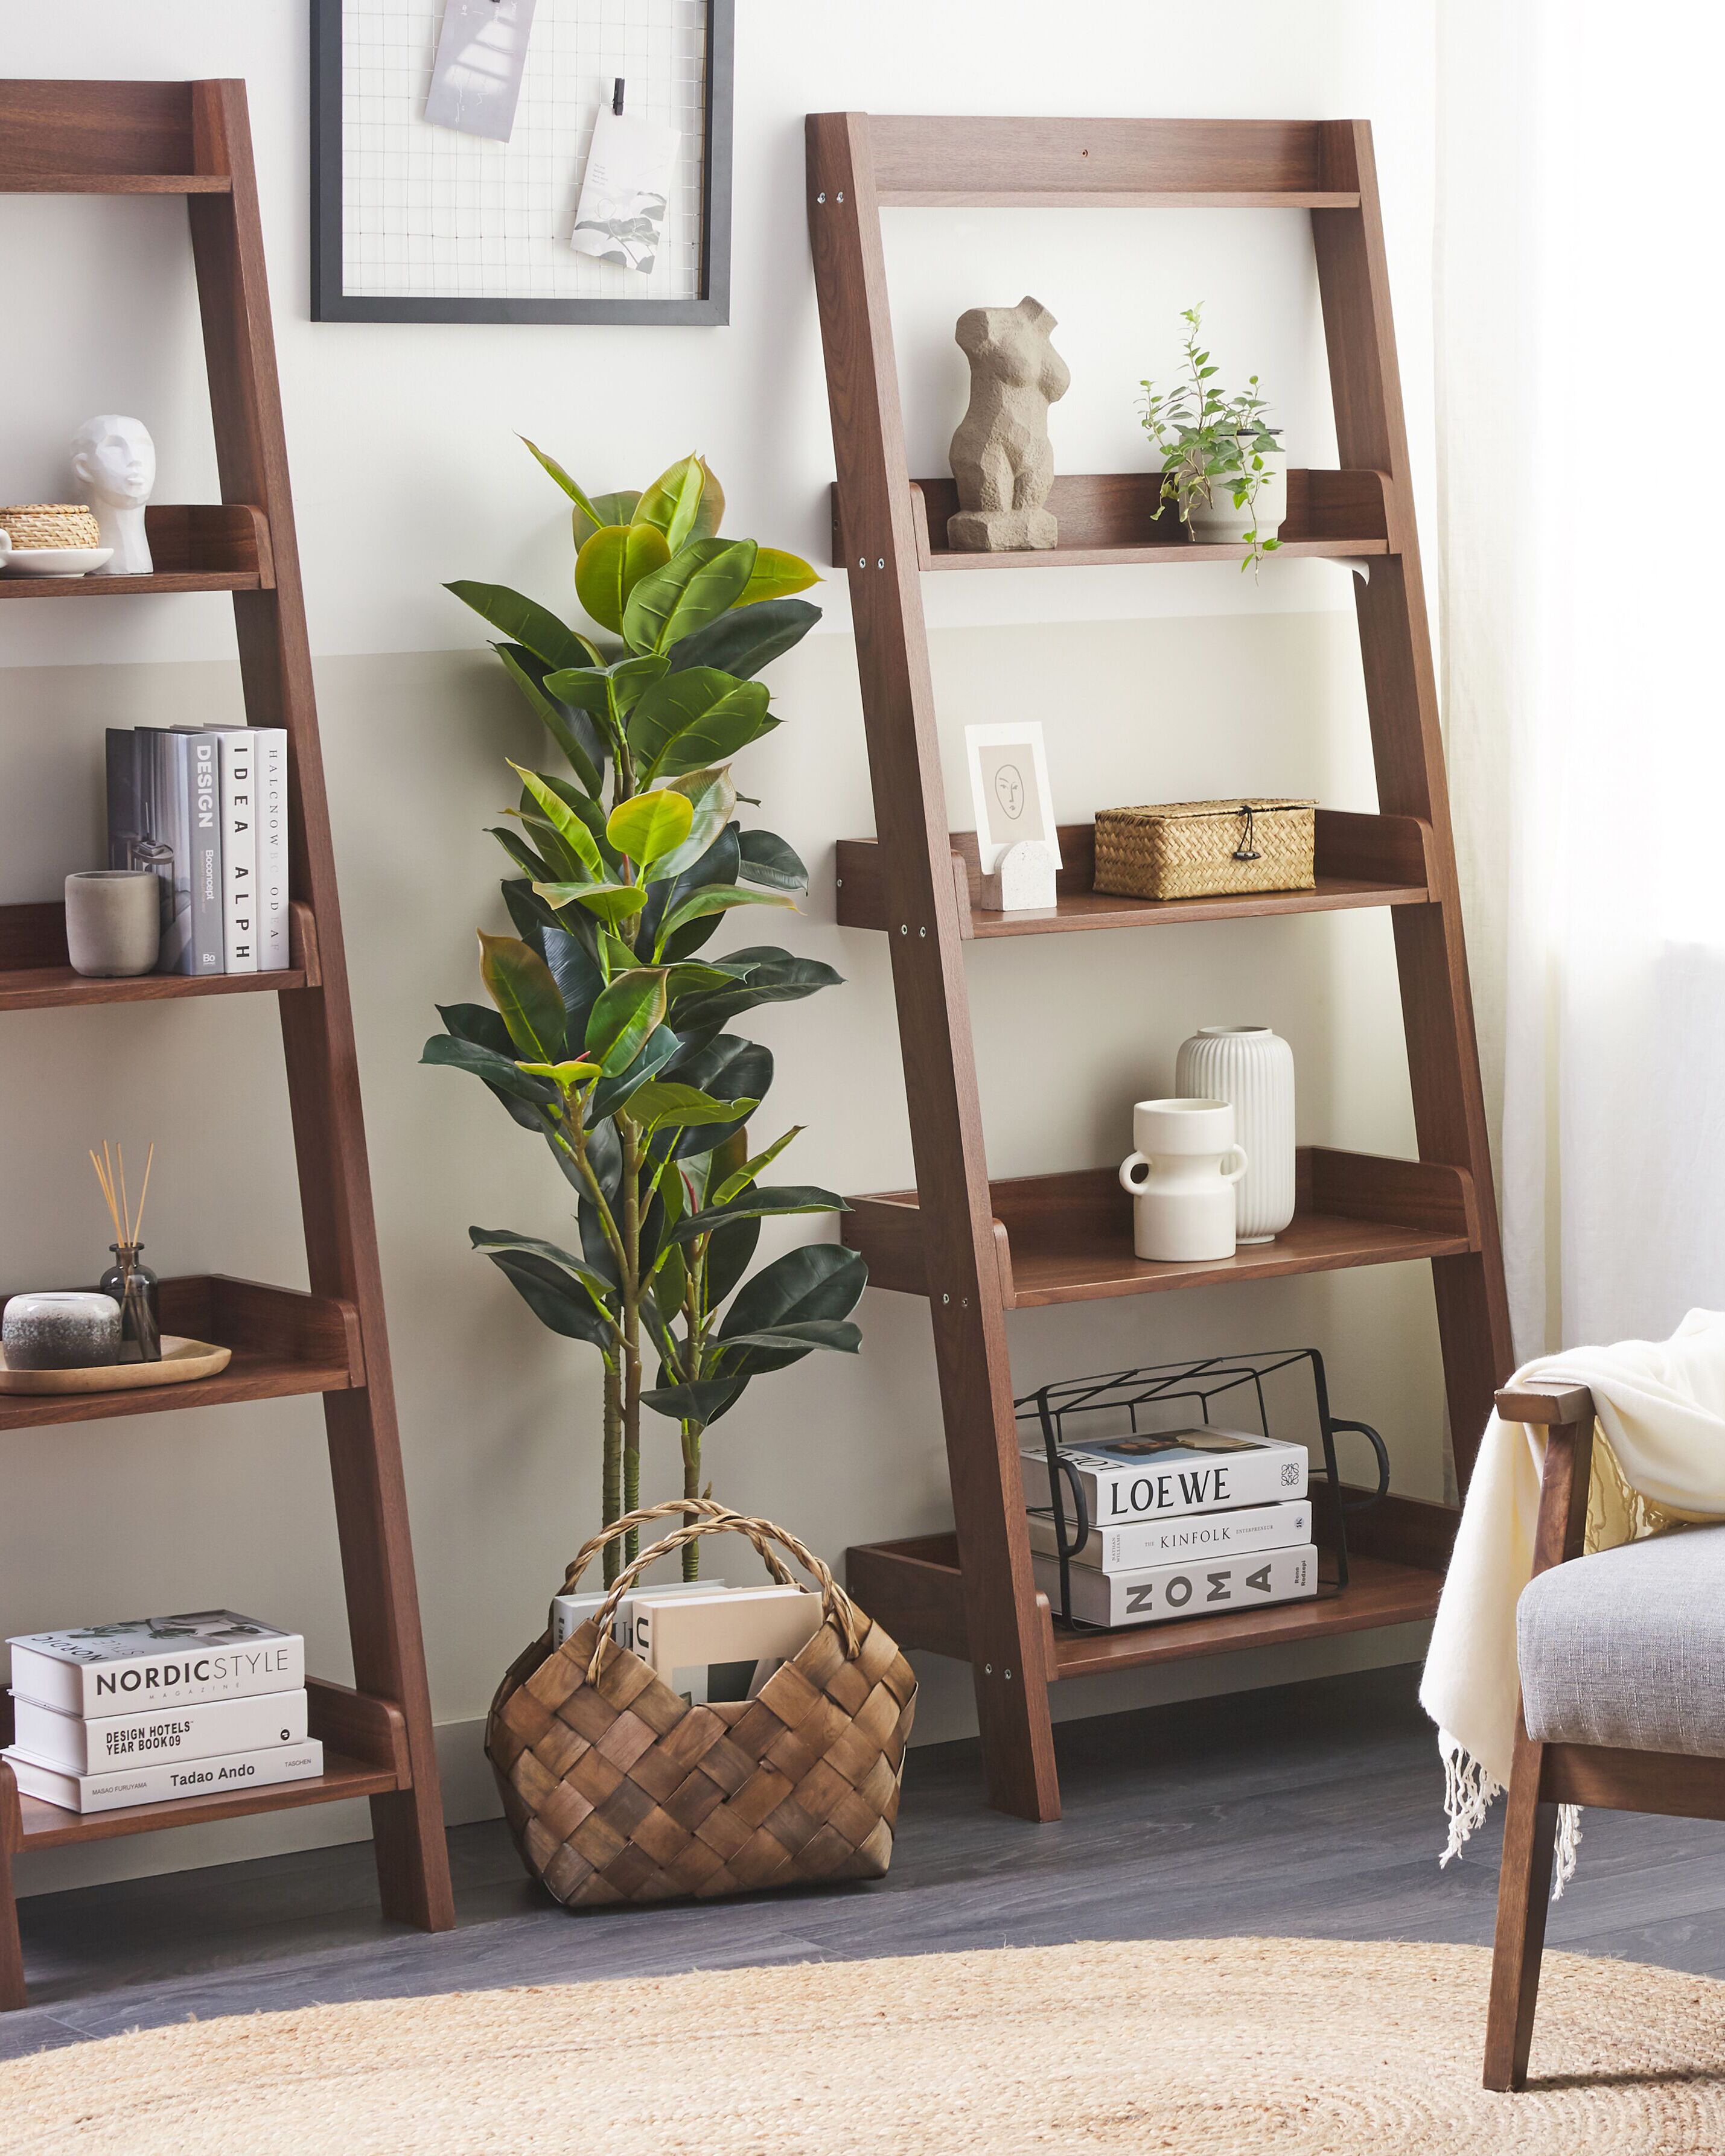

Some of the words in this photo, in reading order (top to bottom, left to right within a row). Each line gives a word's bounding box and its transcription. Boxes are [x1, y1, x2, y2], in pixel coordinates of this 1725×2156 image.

[197, 745, 213, 827] DESIGN
[234, 748, 248, 833] IDEA
[205, 849, 214, 900] Boconcept
[235, 867, 250, 958] ALPH
[203, 953, 215, 962] Bo
[1111, 1468, 1231, 1515] LOEWE
[1161, 1527, 1231, 1548] KINFOLK
[1126, 1563, 1271, 1614] NOMA
[31, 1636, 109, 1661] NORDIC
[106, 1728, 145, 1744] DESIGN
[150, 1721, 191, 1738] HOTELS
[107, 1741, 134, 1755] YEAR
[284, 1758, 311, 1767] TASCHEN
[170, 1771, 214, 1787] Tadao
[218, 1764, 255, 1780] Ando
[92, 1787, 114, 1795] MASAO
[115, 1782, 147, 1792] FURUYAMA
